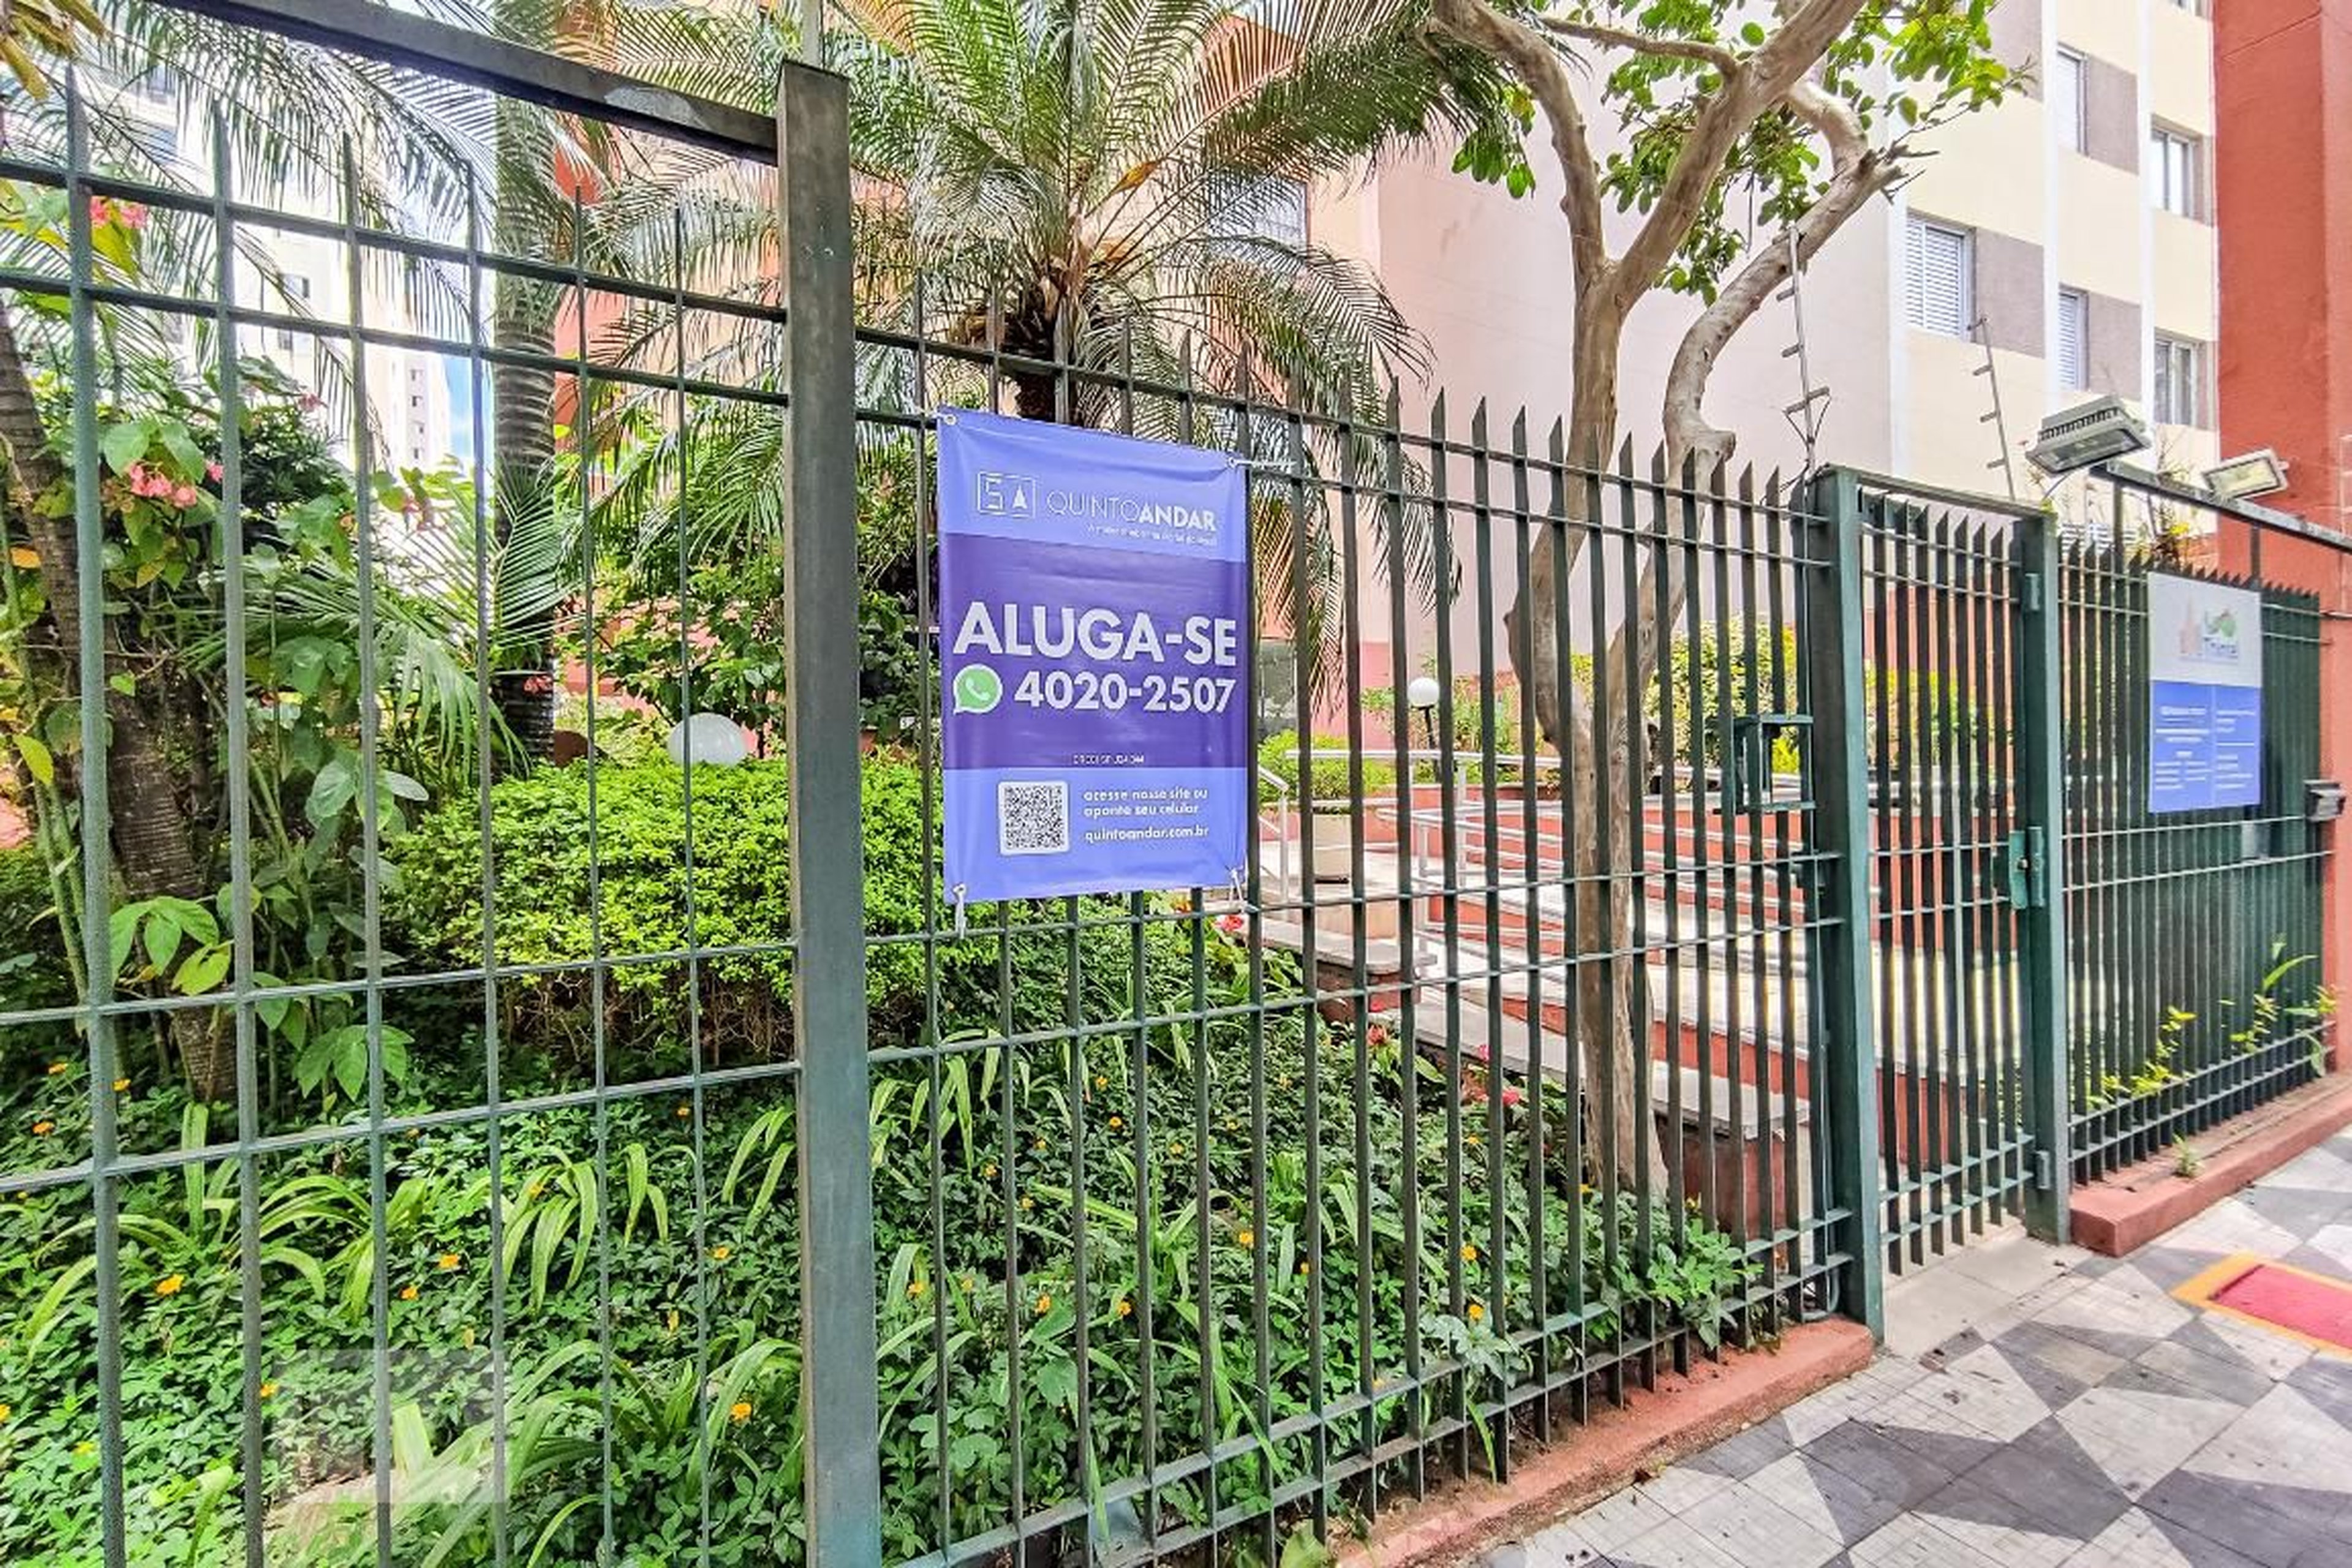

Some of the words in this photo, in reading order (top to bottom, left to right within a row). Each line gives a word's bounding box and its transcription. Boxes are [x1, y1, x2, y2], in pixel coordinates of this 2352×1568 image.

[1046, 491, 1217, 532] QUINTOANDAR
[952, 601, 1237, 666] ALUGA-SE
[1014, 671, 1236, 714] 4020-2507
[1084, 790, 1128, 801] acesse
[1169, 786, 1191, 799] site
[1193, 788, 1208, 799] ou
[1084, 805, 1132, 819] aponte
[1134, 805, 1157, 815] seu
[1159, 802, 1199, 815] celular
[1085, 824, 1209, 844] quintoandar.com.br
